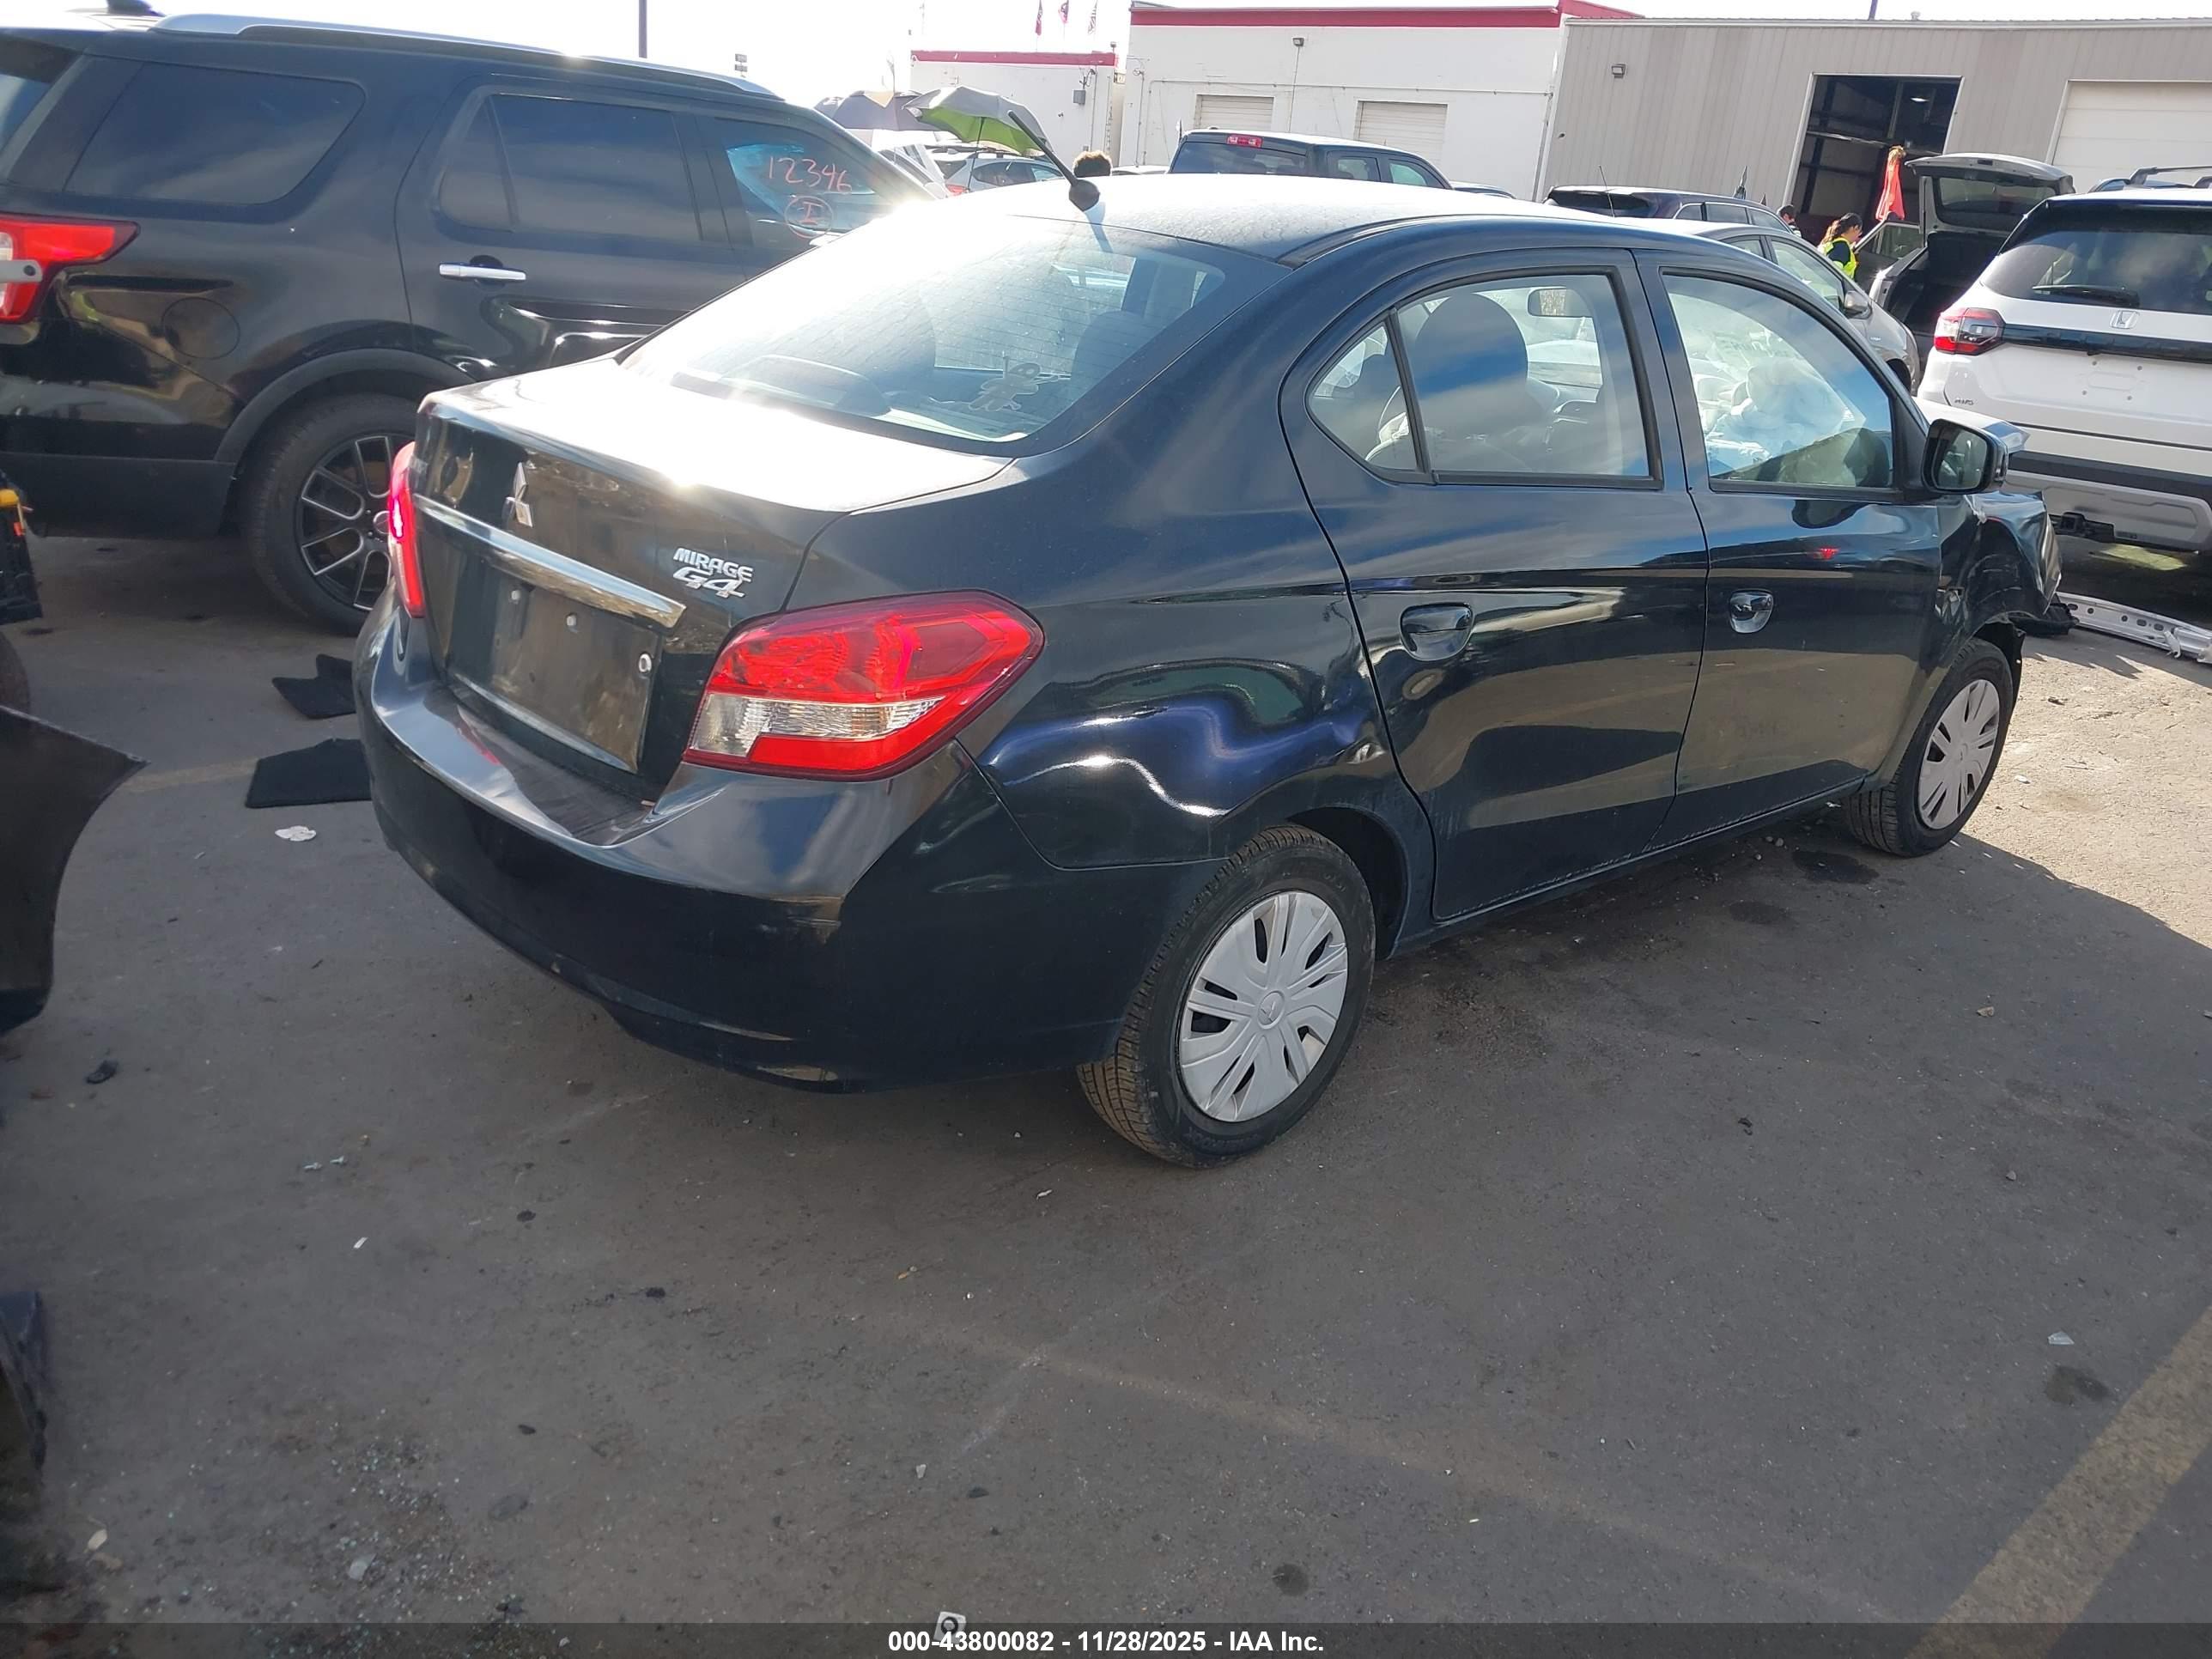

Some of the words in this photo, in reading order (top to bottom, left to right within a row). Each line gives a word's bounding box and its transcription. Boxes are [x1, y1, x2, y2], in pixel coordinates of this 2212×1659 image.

[769, 156, 853, 195] 12346
[672, 547, 754, 583] MIRAGE
[672, 566, 746, 599] G4
